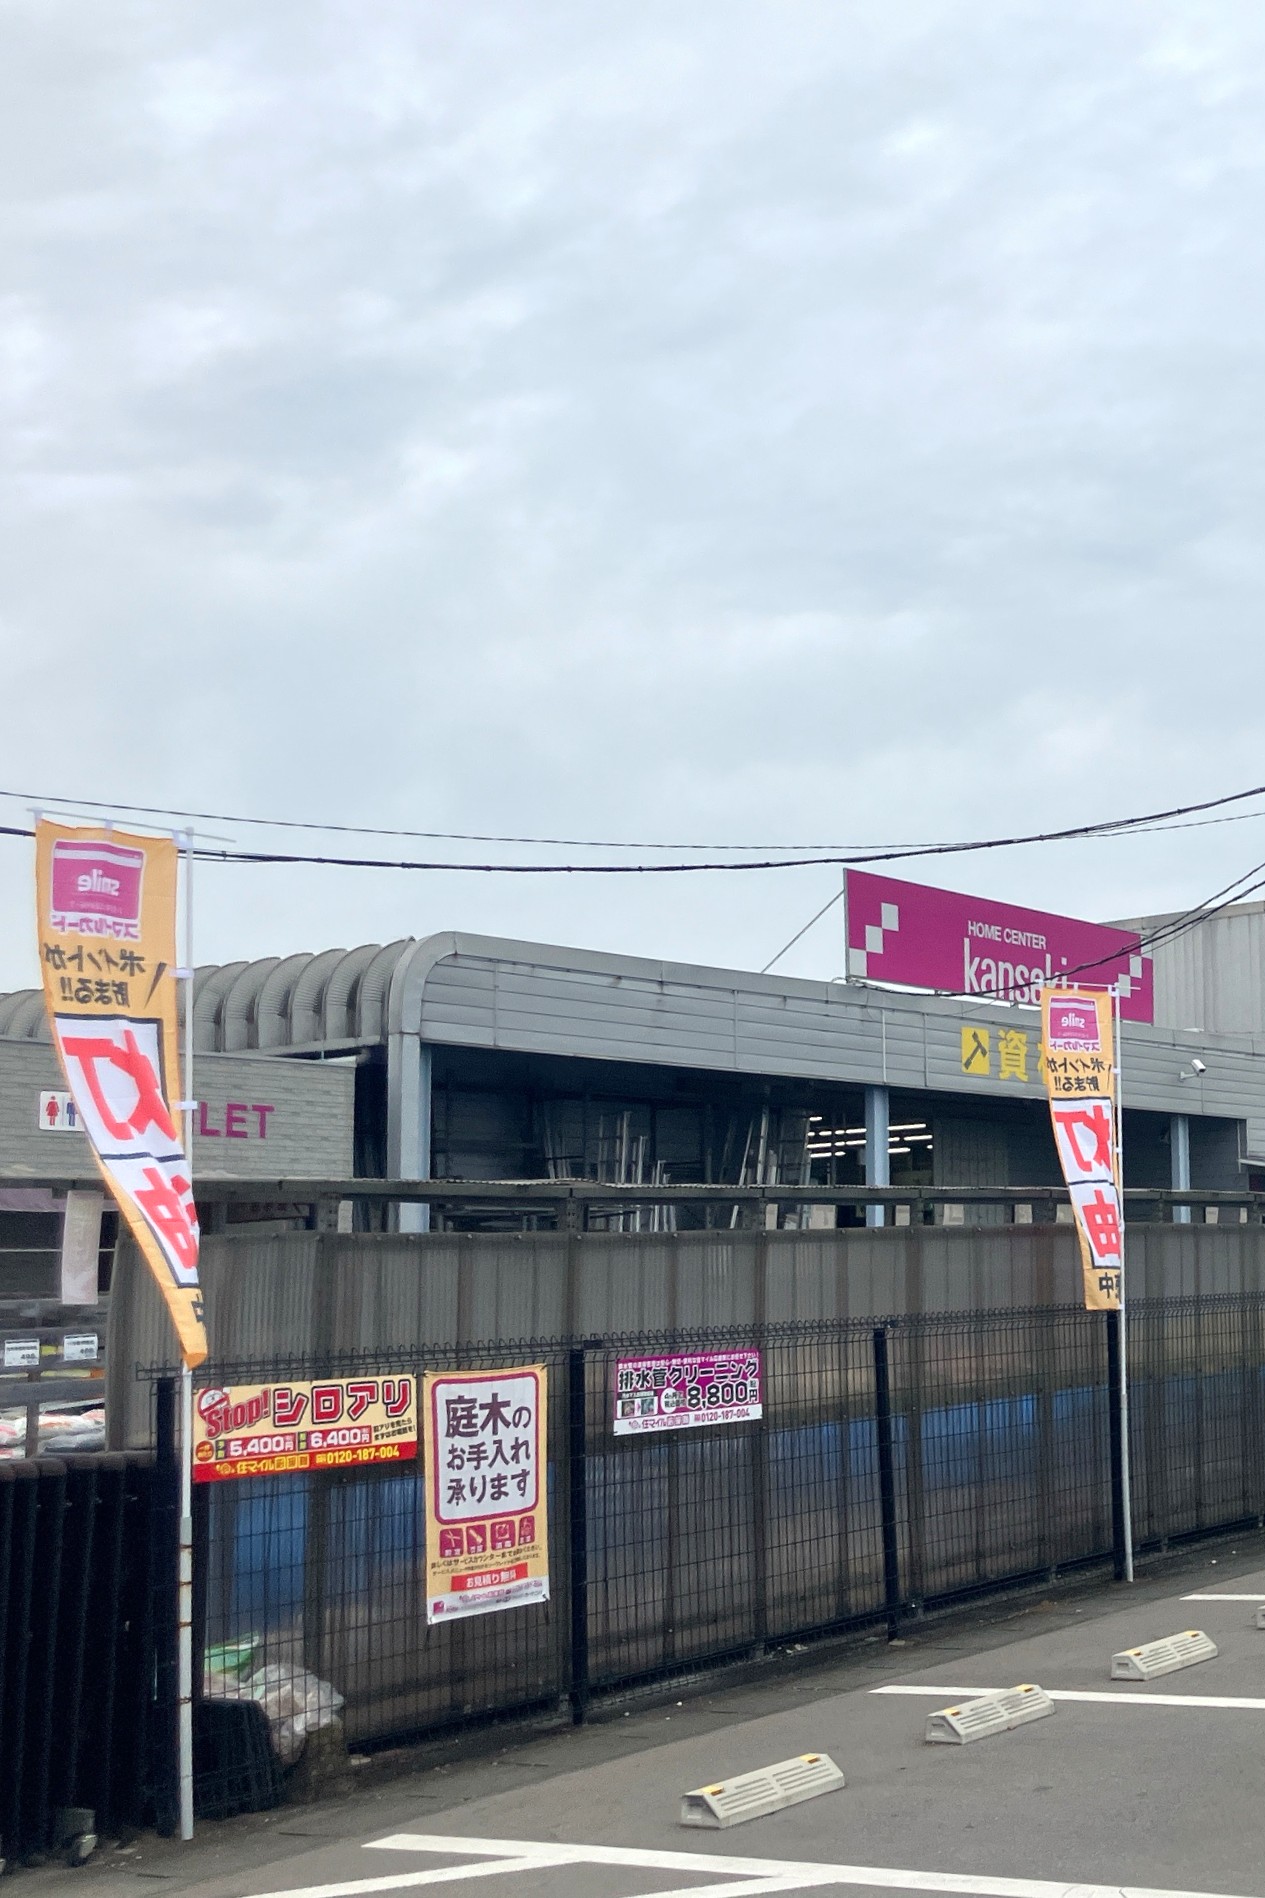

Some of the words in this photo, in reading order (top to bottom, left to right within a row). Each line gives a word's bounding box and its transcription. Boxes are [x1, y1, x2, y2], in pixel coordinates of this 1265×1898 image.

[967, 919, 1002, 942] HOME
[1003, 928, 1047, 950] CENTER
[191, 1101, 275, 1139] LET
[618, 1358, 759, 1391] 排水管クリーニング
[205, 1387, 272, 1439] Stop!
[273, 1378, 411, 1427] シロアリ
[445, 1392, 532, 1439] 庭木の
[701, 1408, 750, 1422] 0120-187-004
[326, 1445, 400, 1464] 0120-187-004
[446, 1436, 531, 1471] お手入れ
[446, 1468, 531, 1506] 承ります
